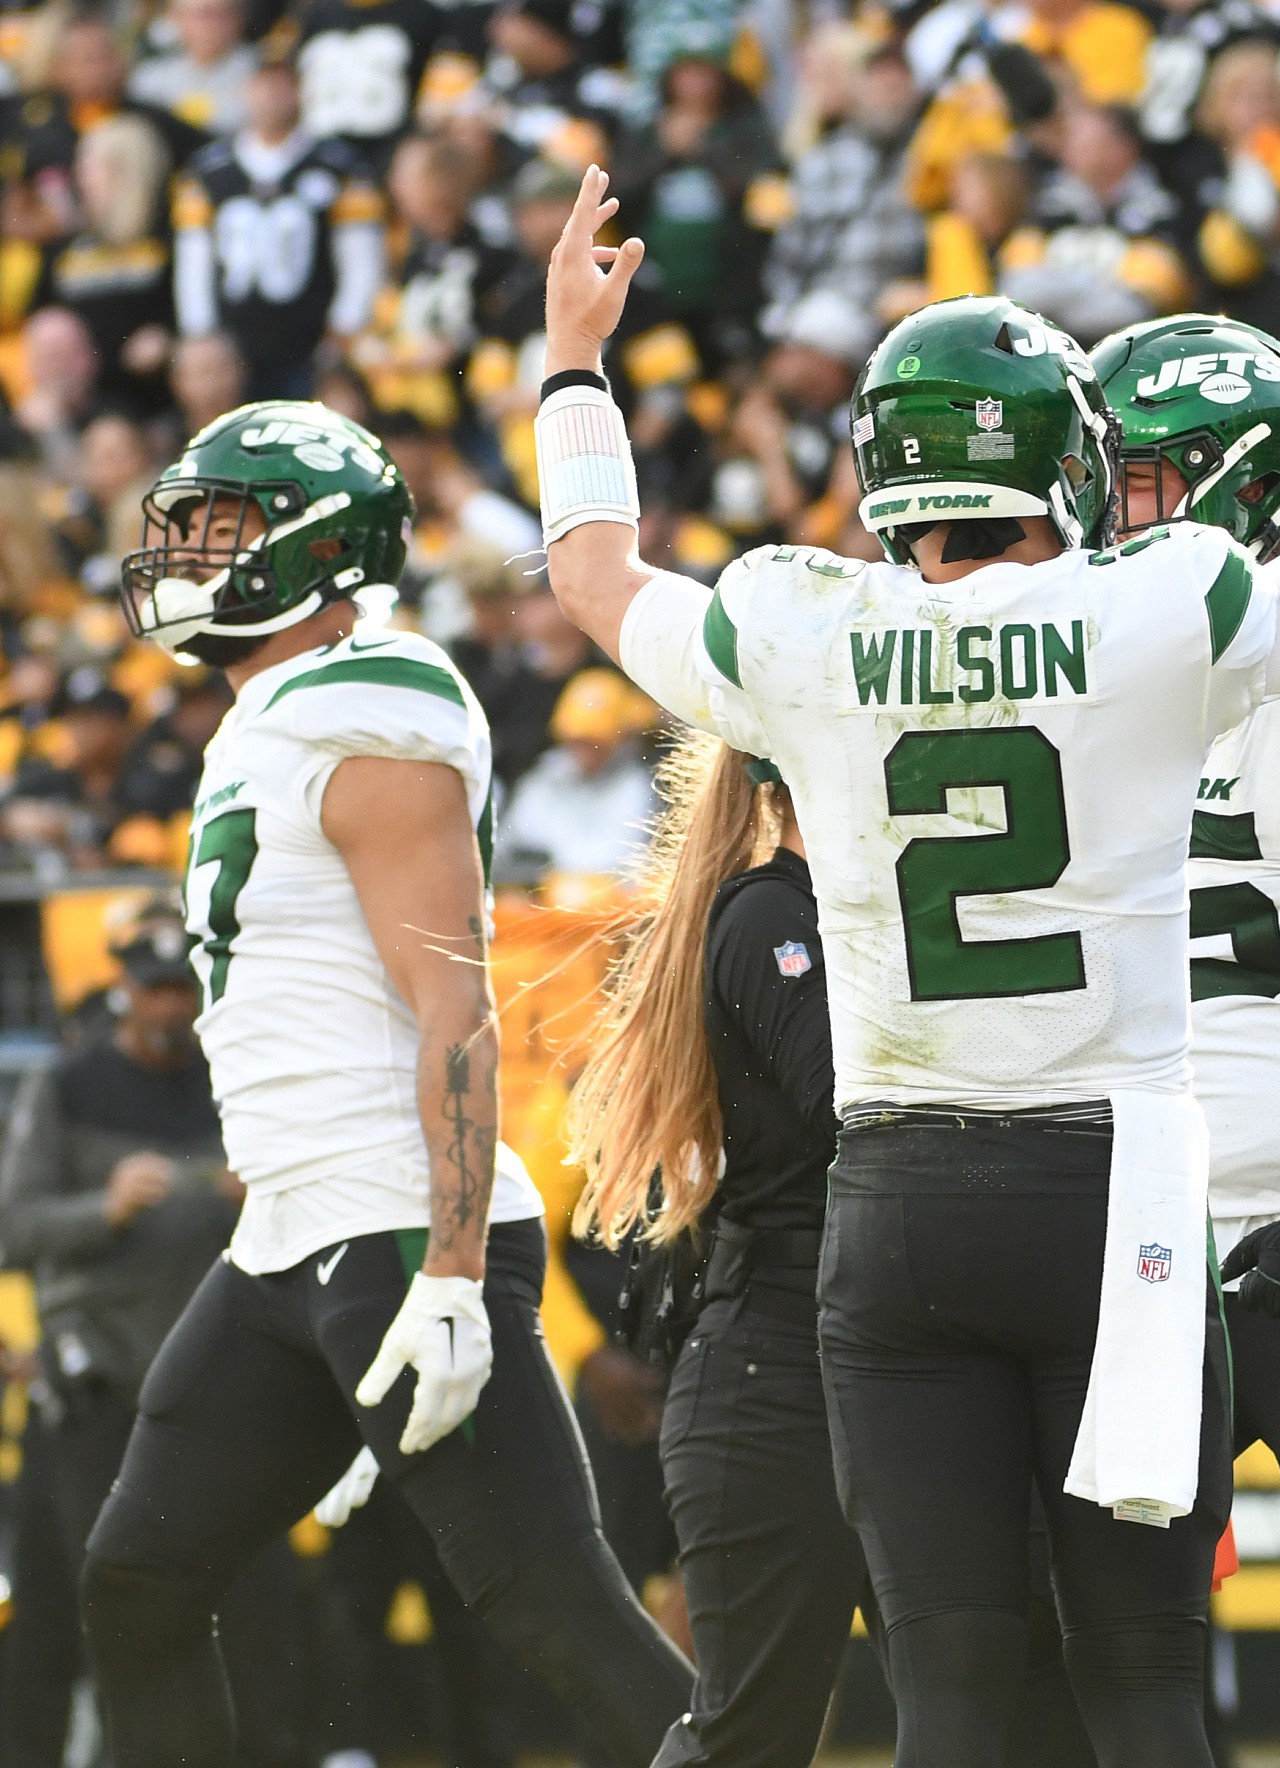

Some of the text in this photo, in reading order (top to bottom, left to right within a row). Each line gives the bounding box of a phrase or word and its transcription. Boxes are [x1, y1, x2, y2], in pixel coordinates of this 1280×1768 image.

[979, 412, 999, 425] NFL
[240, 421, 386, 476] JETS
[903, 438, 921, 464] 2
[869, 495, 993, 519] NEW YORK
[850, 620, 1087, 705] WILSON
[884, 725, 1087, 1002] 2
[1140, 1258, 1168, 1280] NFL
